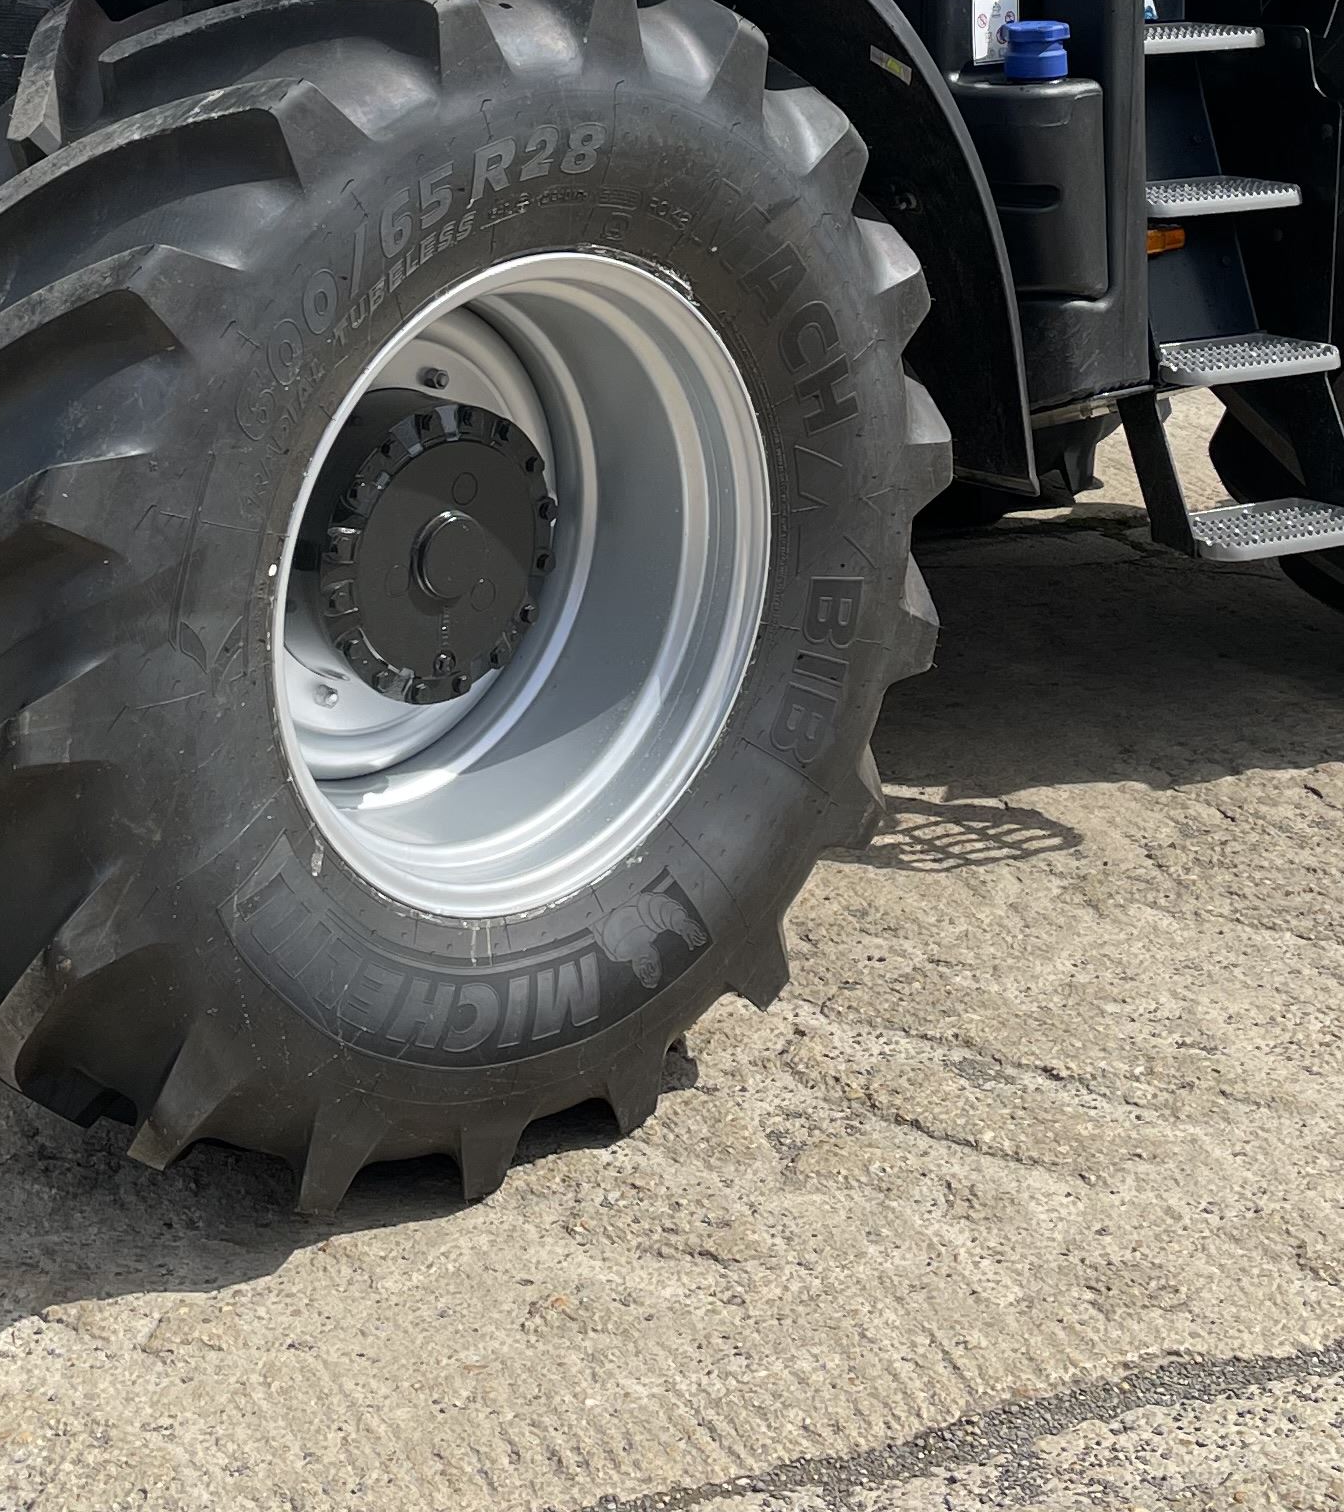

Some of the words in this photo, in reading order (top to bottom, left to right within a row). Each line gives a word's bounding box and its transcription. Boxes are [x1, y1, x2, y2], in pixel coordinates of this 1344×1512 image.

[466, 121, 607, 209] R28
[332, 209, 477, 346] TUBELESS
[769, 574, 865, 766] BIB
